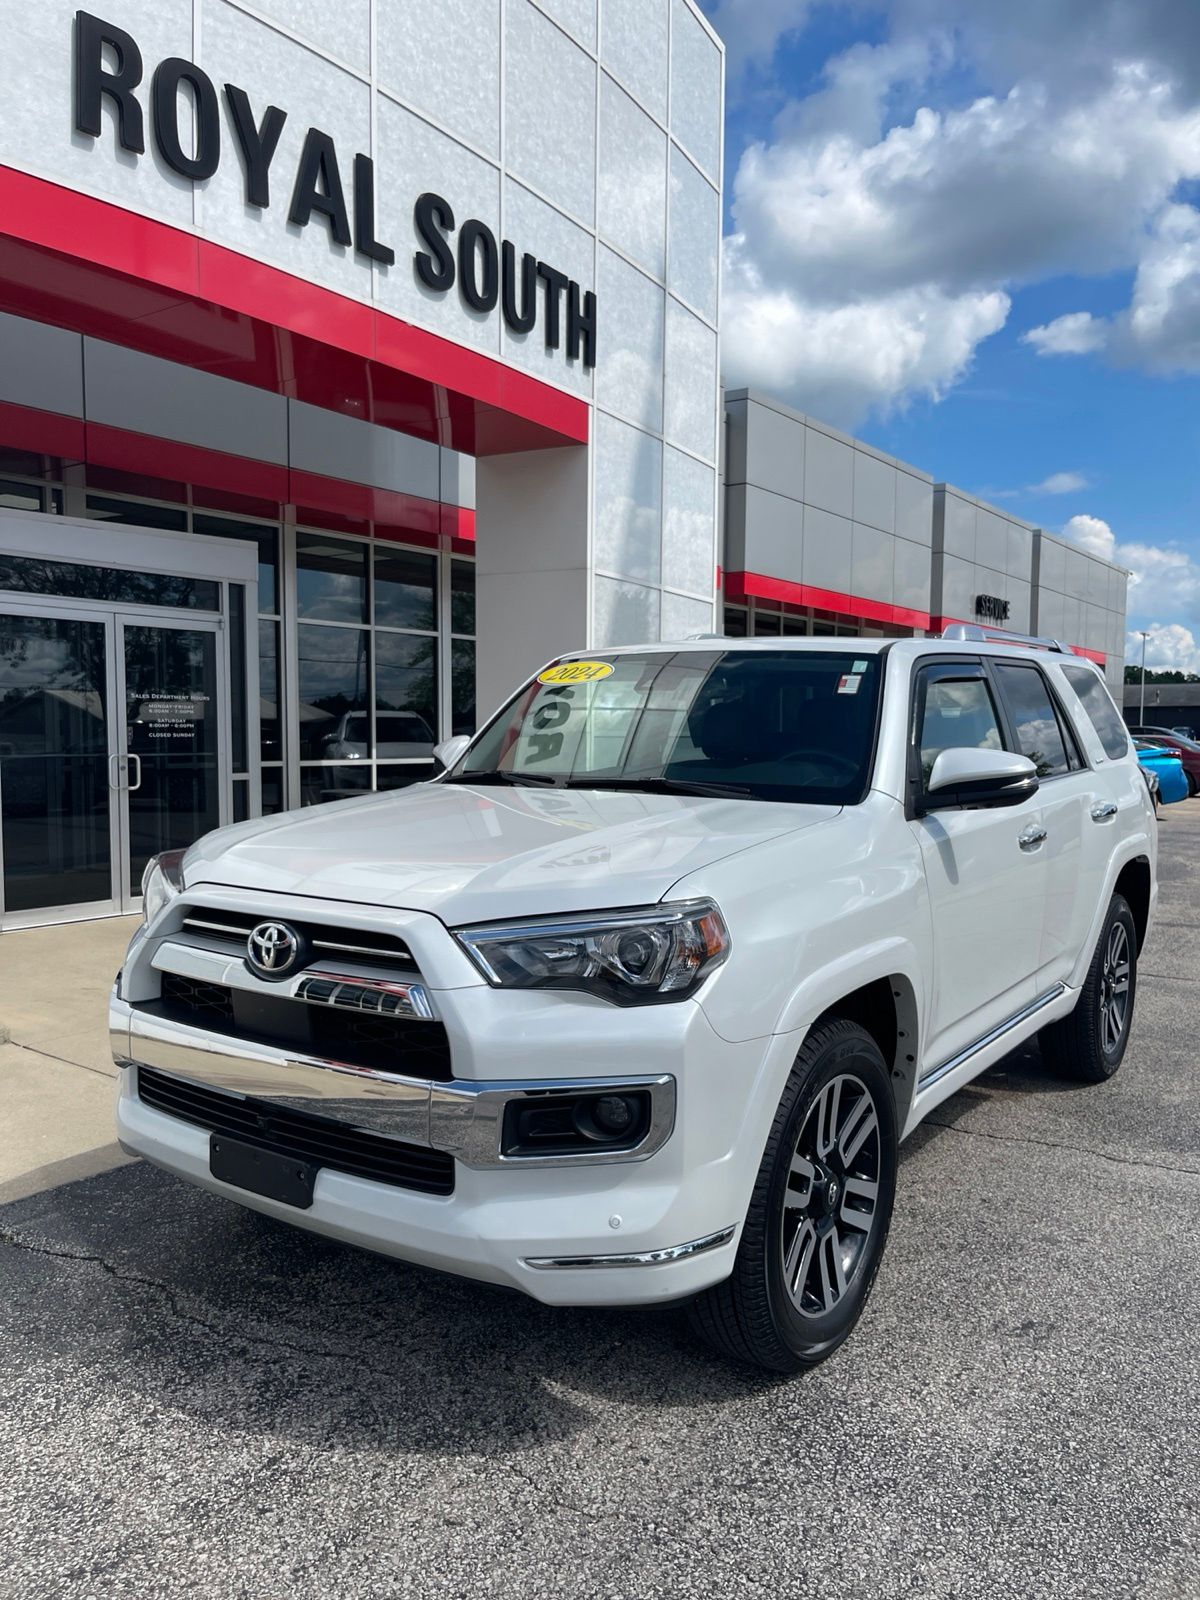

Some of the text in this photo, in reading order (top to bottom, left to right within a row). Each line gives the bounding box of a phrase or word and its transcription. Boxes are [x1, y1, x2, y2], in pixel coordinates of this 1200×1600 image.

[75, 10, 597, 368] ROYAL SOUTH
[975, 594, 1010, 620] SERVICE
[547, 666, 605, 681] 2024
